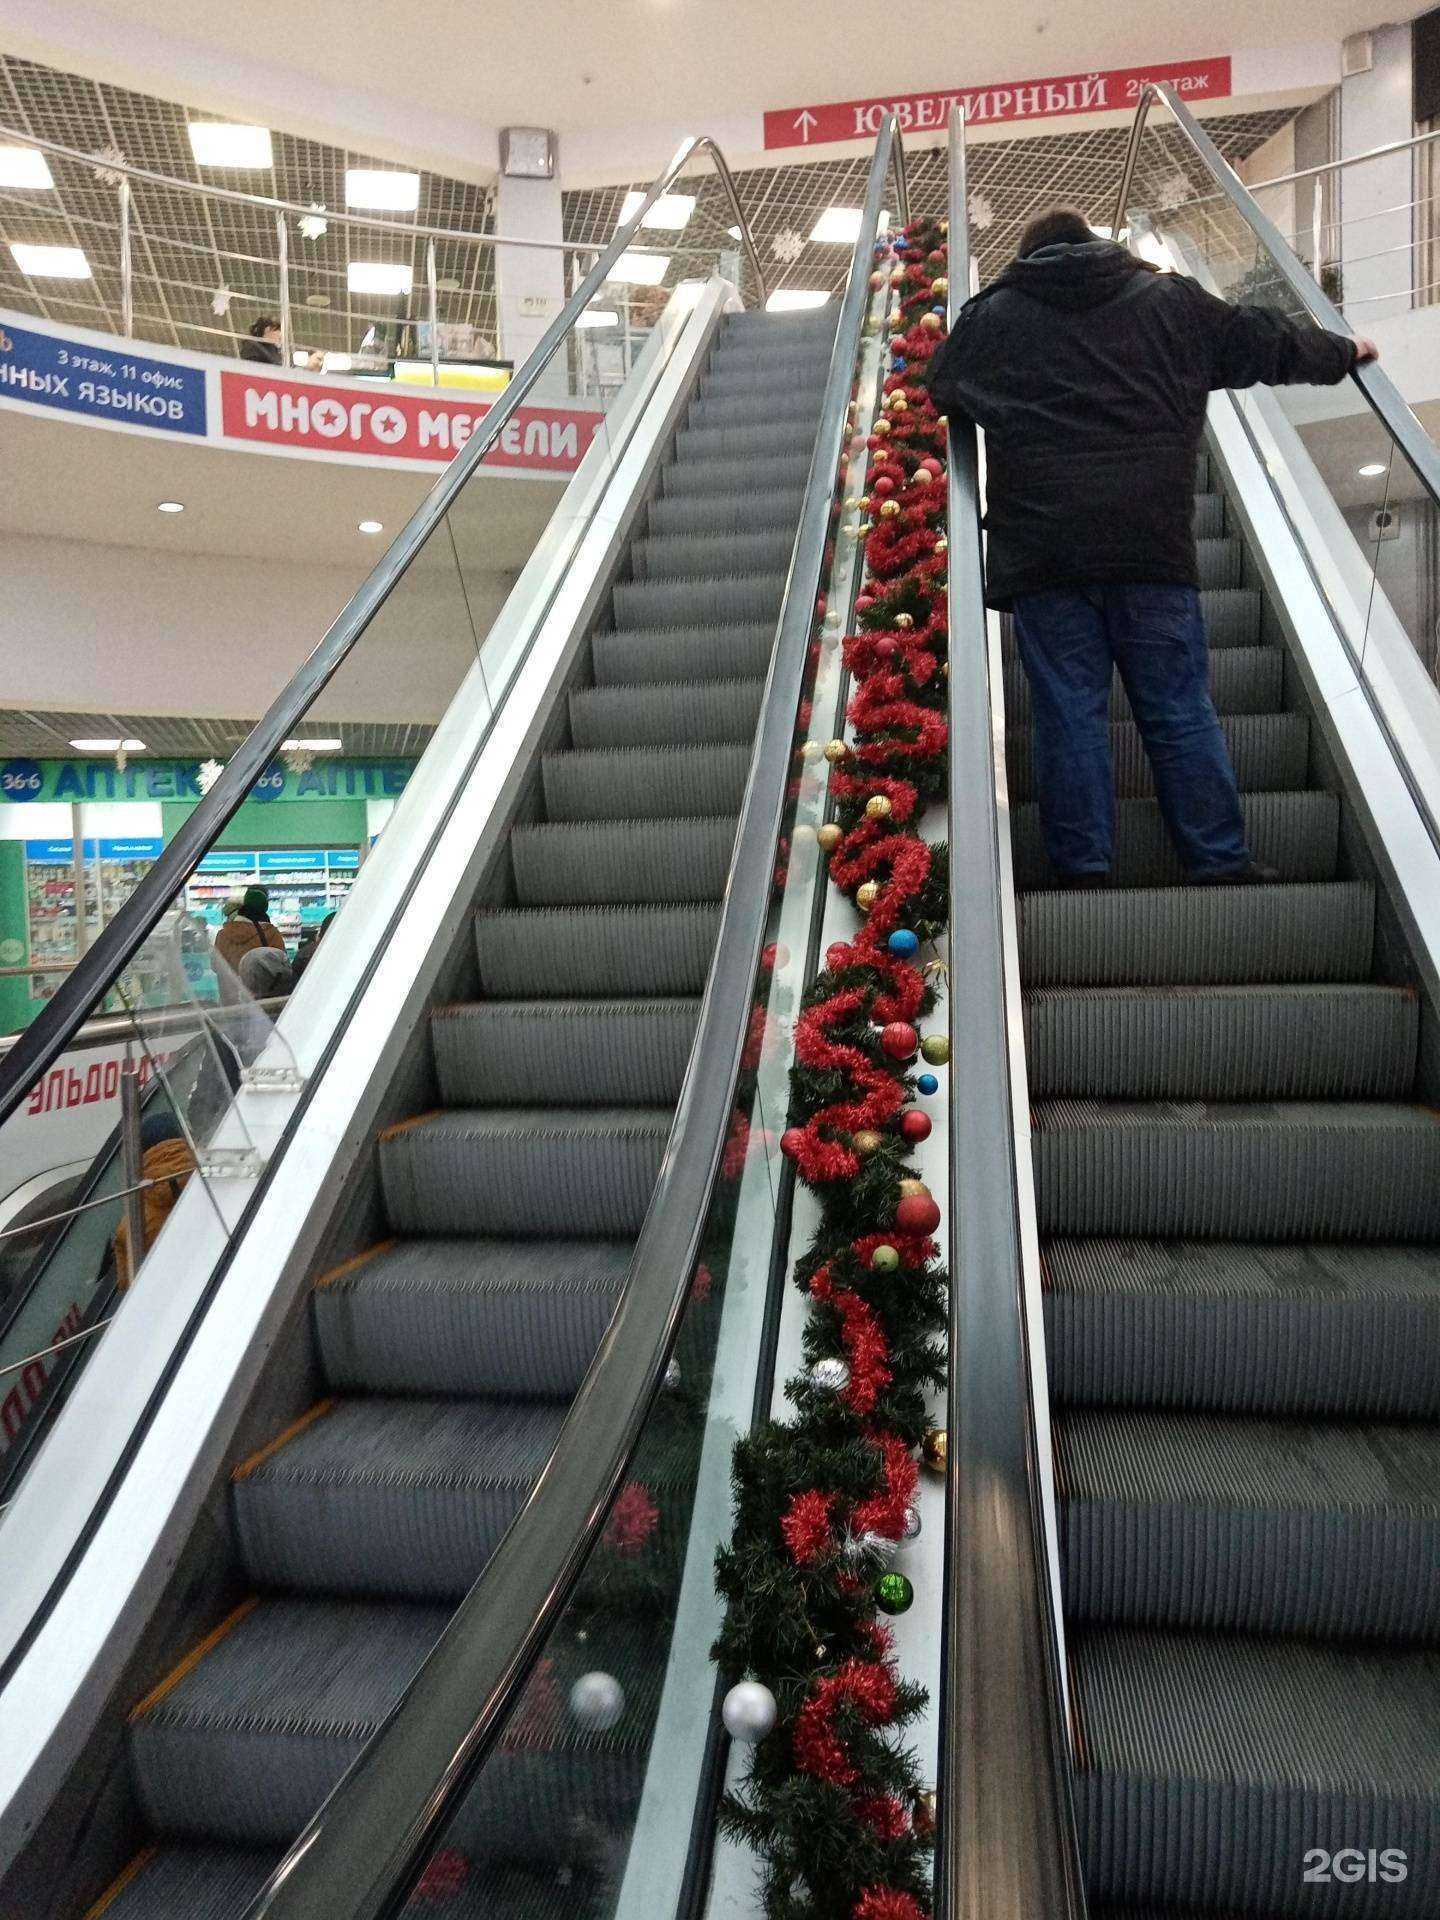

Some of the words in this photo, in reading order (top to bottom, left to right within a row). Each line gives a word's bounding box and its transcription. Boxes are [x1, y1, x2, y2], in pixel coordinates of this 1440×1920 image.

[853, 74, 1108, 135] ЮВЕЛИРНЫЙ
[57, 350, 69, 365] 3
[71, 355, 117, 378] этаж,
[120, 364, 137, 380] 11
[141, 370, 185, 390] офис
[77, 381, 185, 420] ЯЗЫКОВ
[245, 388, 408, 445] МНОГО
[54, 763, 204, 798] АПТЕК
